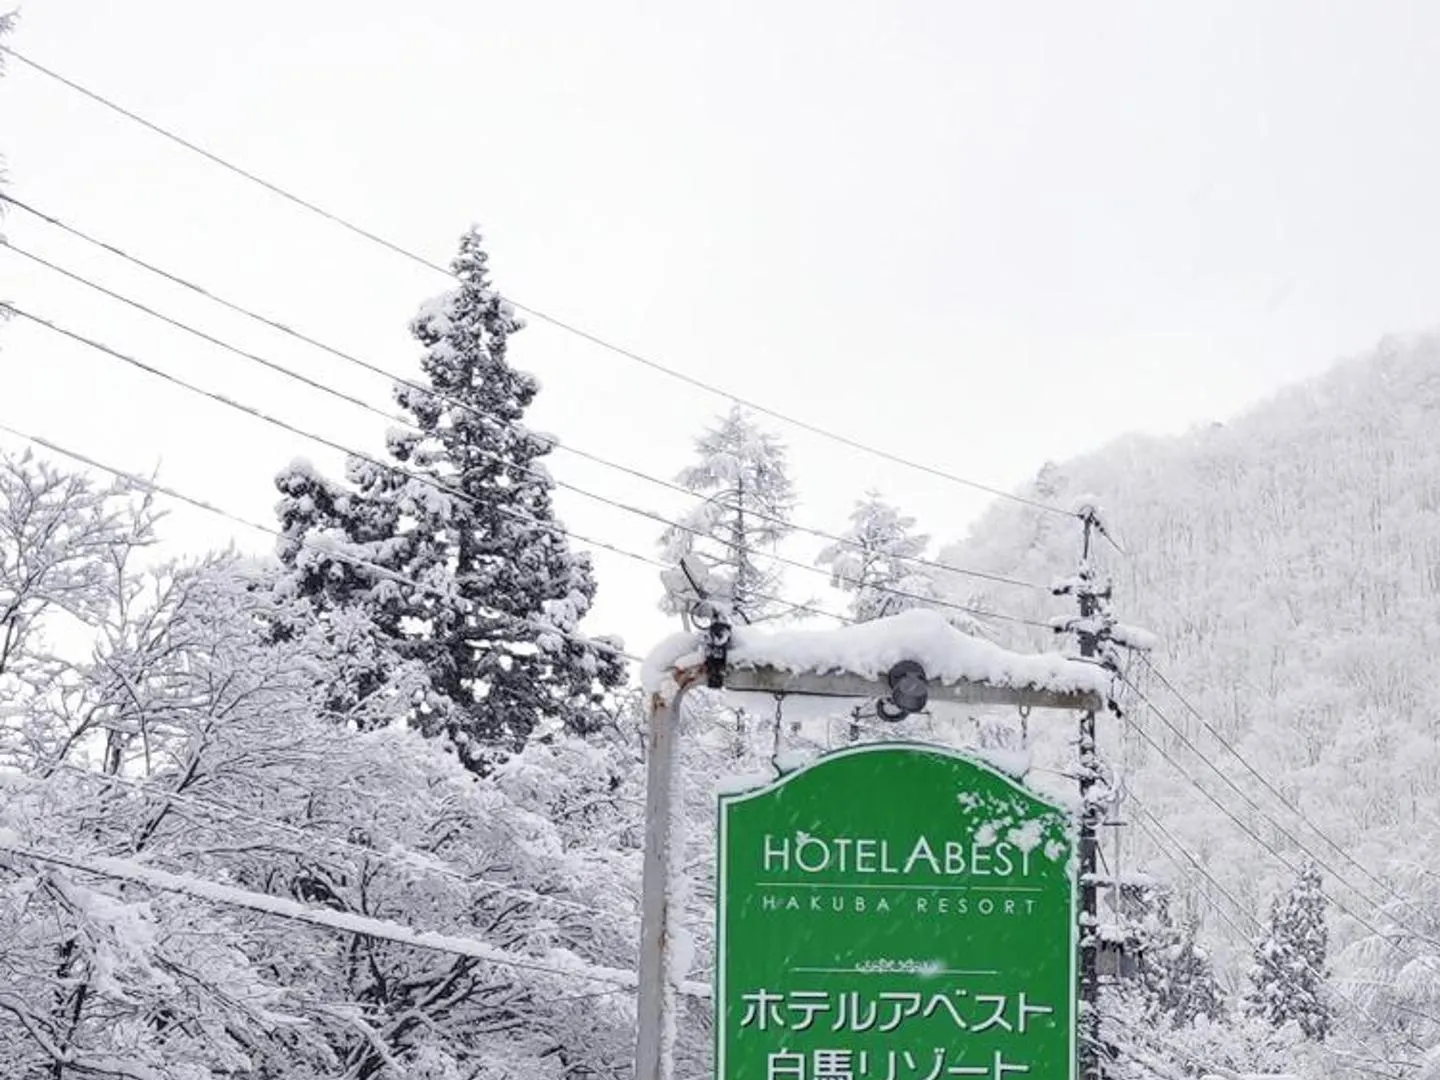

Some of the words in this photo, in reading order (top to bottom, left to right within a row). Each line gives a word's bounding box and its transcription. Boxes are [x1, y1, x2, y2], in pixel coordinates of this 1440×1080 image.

[764, 836, 898, 873] HOTEL
[762, 896, 890, 912] HAKUBA
[916, 897, 1037, 915] RESORT
[740, 988, 1054, 1033] ホテルアベスト
